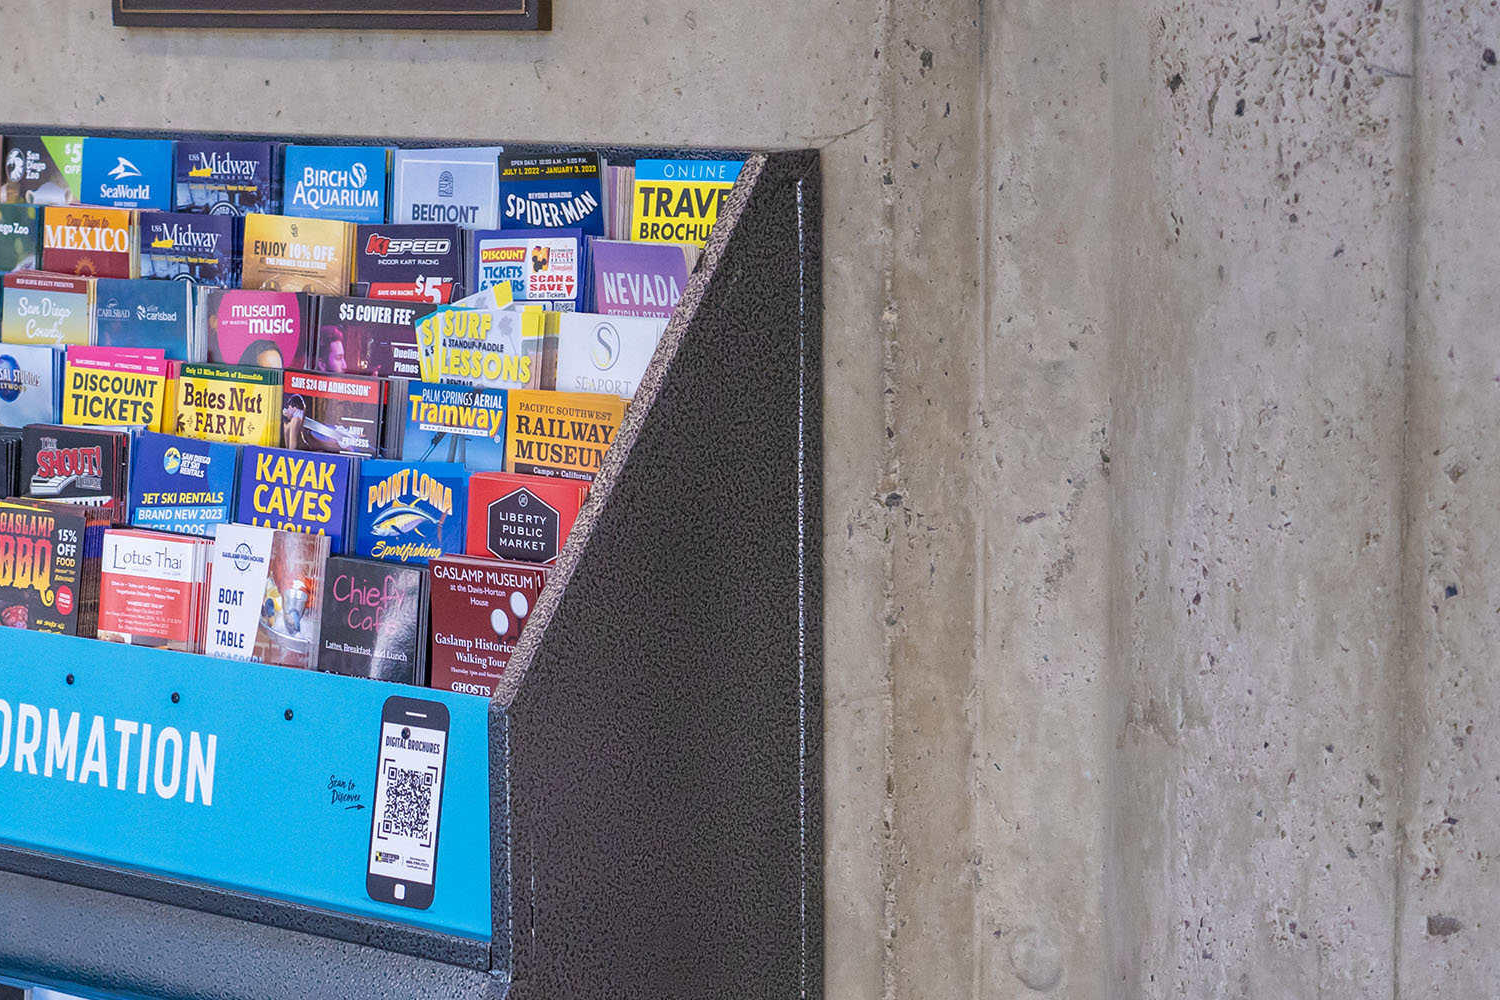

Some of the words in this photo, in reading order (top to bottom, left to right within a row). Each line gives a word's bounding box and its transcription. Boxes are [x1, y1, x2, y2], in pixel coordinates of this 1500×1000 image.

[304, 167, 348, 188] BIRCH
[664, 164, 726, 180] ONLINE
[100, 184, 150, 200] SeaWorld
[292, 181, 378, 210] AQUARIUM
[412, 204, 479, 224] BELMONT
[506, 190, 598, 228] SPIDER-MAN
[14, 222, 29, 235] Zoo
[44, 224, 129, 253] MEXICO
[378, 258, 397, 266] INDOOR
[398, 258, 415, 266] KART
[418, 258, 439, 266] RACING
[482, 248, 526, 262] DISCOUNT
[484, 266, 522, 280] TICKETS
[18, 298, 41, 318] San
[42, 298, 72, 320] Diego
[232, 305, 286, 318] museum
[26, 318, 65, 340] County
[249, 318, 294, 335] music
[443, 310, 492, 340] SURF
[441, 348, 532, 384] LESSONS
[73, 372, 158, 398] DISCOUNT
[576, 376, 632, 395] SEAPORT
[184, 382, 226, 408] Bates
[228, 387, 262, 414] Nut
[422, 388, 440, 404] PALM
[442, 390, 473, 408] SPRINGS
[474, 393, 503, 410] AERIAL
[72, 393, 154, 425] TICKETS
[410, 395, 504, 437] Tramway
[519, 402, 554, 416] PACIFIC
[556, 406, 613, 421] SOUTHWEST
[194, 412, 246, 437] FARM
[516, 414, 614, 445] RAILWAY
[37, 446, 102, 480] SHOUT!
[256, 452, 336, 492] KAYAK
[533, 466, 554, 477] Campo
[560, 468, 592, 482] California
[142, 493, 160, 505] JET
[161, 493, 178, 505] SKI
[178, 492, 224, 504] RENTALS
[368, 468, 410, 513] POINT
[412, 470, 453, 516] LOMA
[254, 484, 333, 523] CAVES
[138, 509, 169, 522] BRAND
[171, 509, 198, 520] NEW
[199, 508, 222, 520] 2023
[500, 511, 547, 526] LIBERTY
[0, 512, 54, 538] GASLAMP
[502, 525, 543, 538] PUBLIC
[58, 528, 78, 543] 15%
[500, 538, 546, 552] MARKET
[57, 543, 77, 558] OFF
[114, 544, 152, 572] Lotus
[156, 548, 182, 570] Thai
[56, 556, 76, 568] FOOD
[434, 565, 484, 585] GASLAMP
[486, 572, 534, 593] MUSEUM
[218, 588, 244, 606] BOAT
[450, 584, 456, 592] at
[456, 585, 466, 594] the
[467, 586, 507, 599] Davis-Horton
[470, 597, 490, 608] House
[218, 608, 230, 625] TO
[216, 630, 244, 650] TABLE
[456, 652, 488, 670] Walking
[488, 656, 507, 668] Tour
[451, 681, 492, 697] GHOSTS
[385, 736, 407, 750] DIGITAL
[408, 739, 441, 756] BROCHURES
[328, 774, 348, 790] Scan
[348, 778, 356, 792] to
[331, 788, 362, 805] Discover
